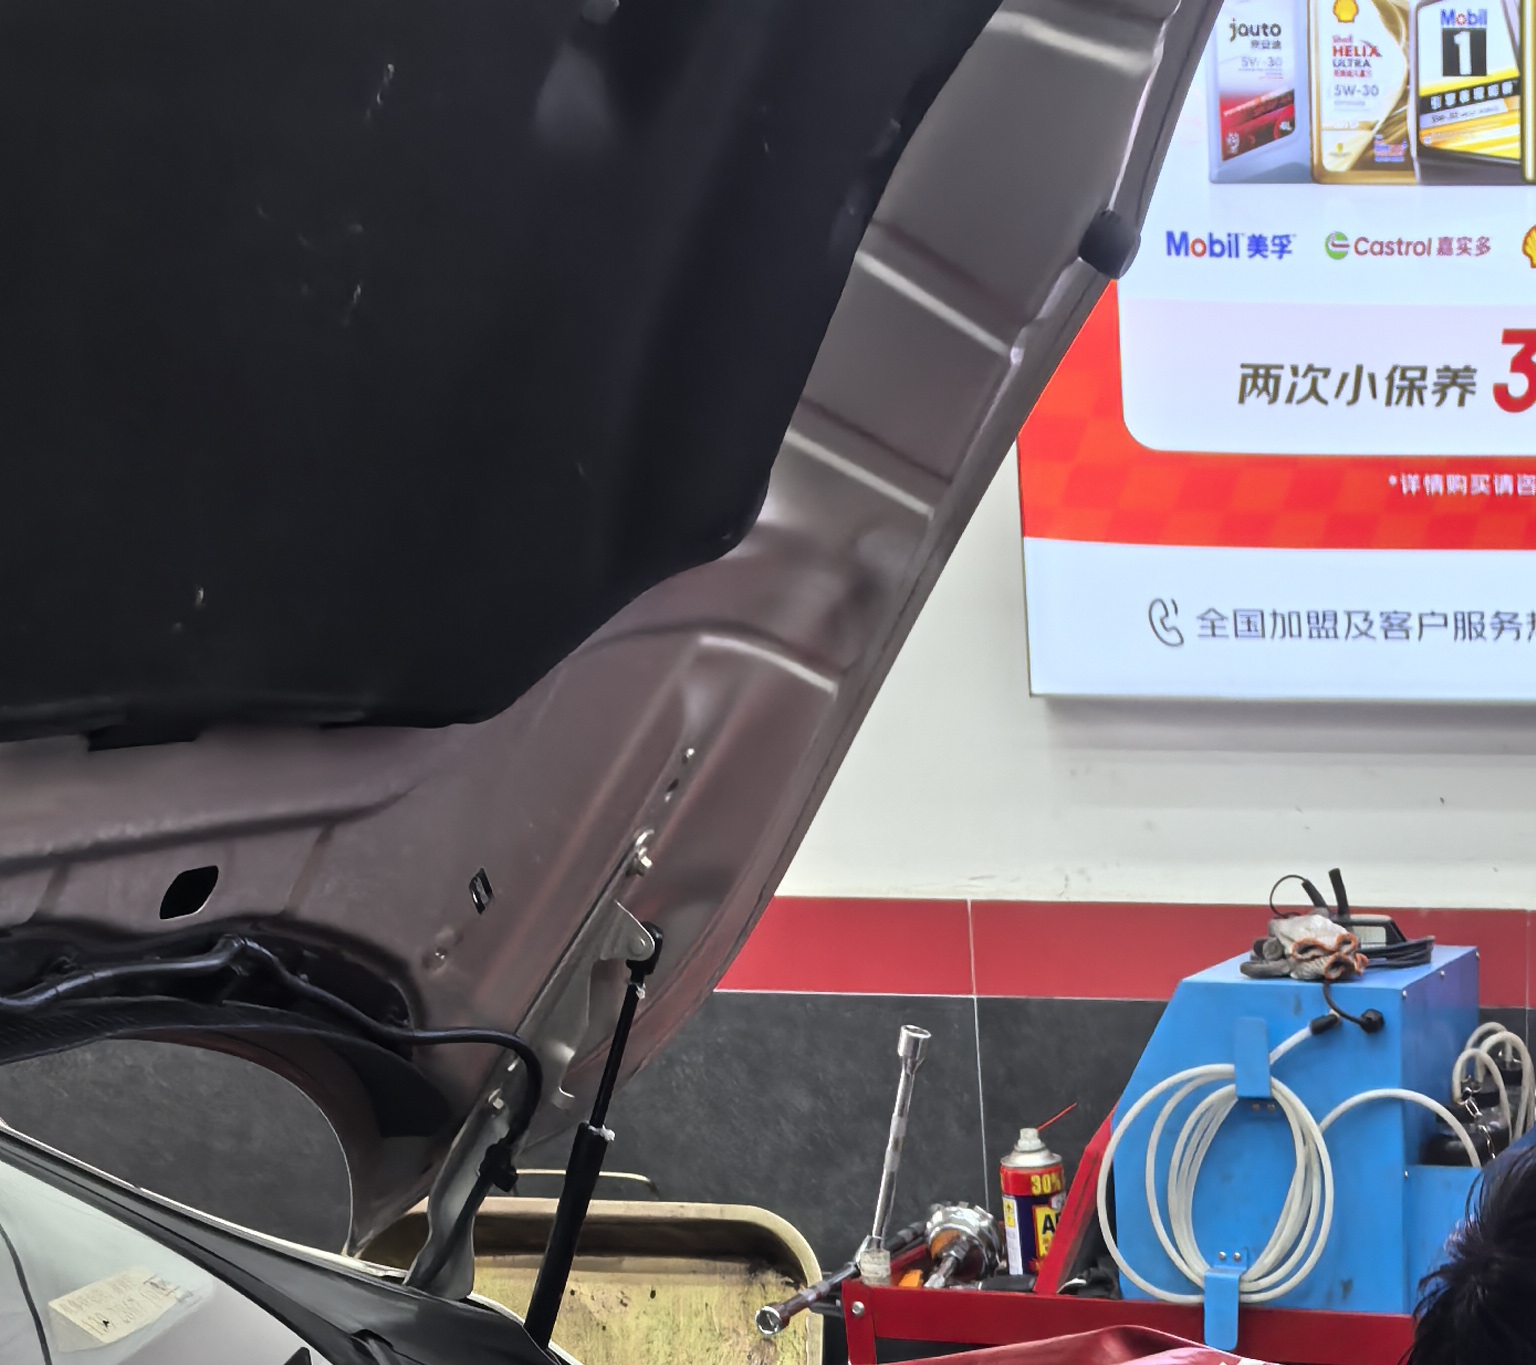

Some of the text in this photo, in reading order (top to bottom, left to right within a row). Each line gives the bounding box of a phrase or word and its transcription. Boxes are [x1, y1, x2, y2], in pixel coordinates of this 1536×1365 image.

[1440, 9, 1487, 26] Mobil
[1229, 18, 1282, 42] jauto
[1332, 44, 1383, 58] HELIX
[1453, 30, 1472, 76] 1
[1166, 230, 1294, 260] Mobil 美孚
[1354, 236, 1432, 257] Castrol
[1236, 362, 1478, 409] 两次小保养
